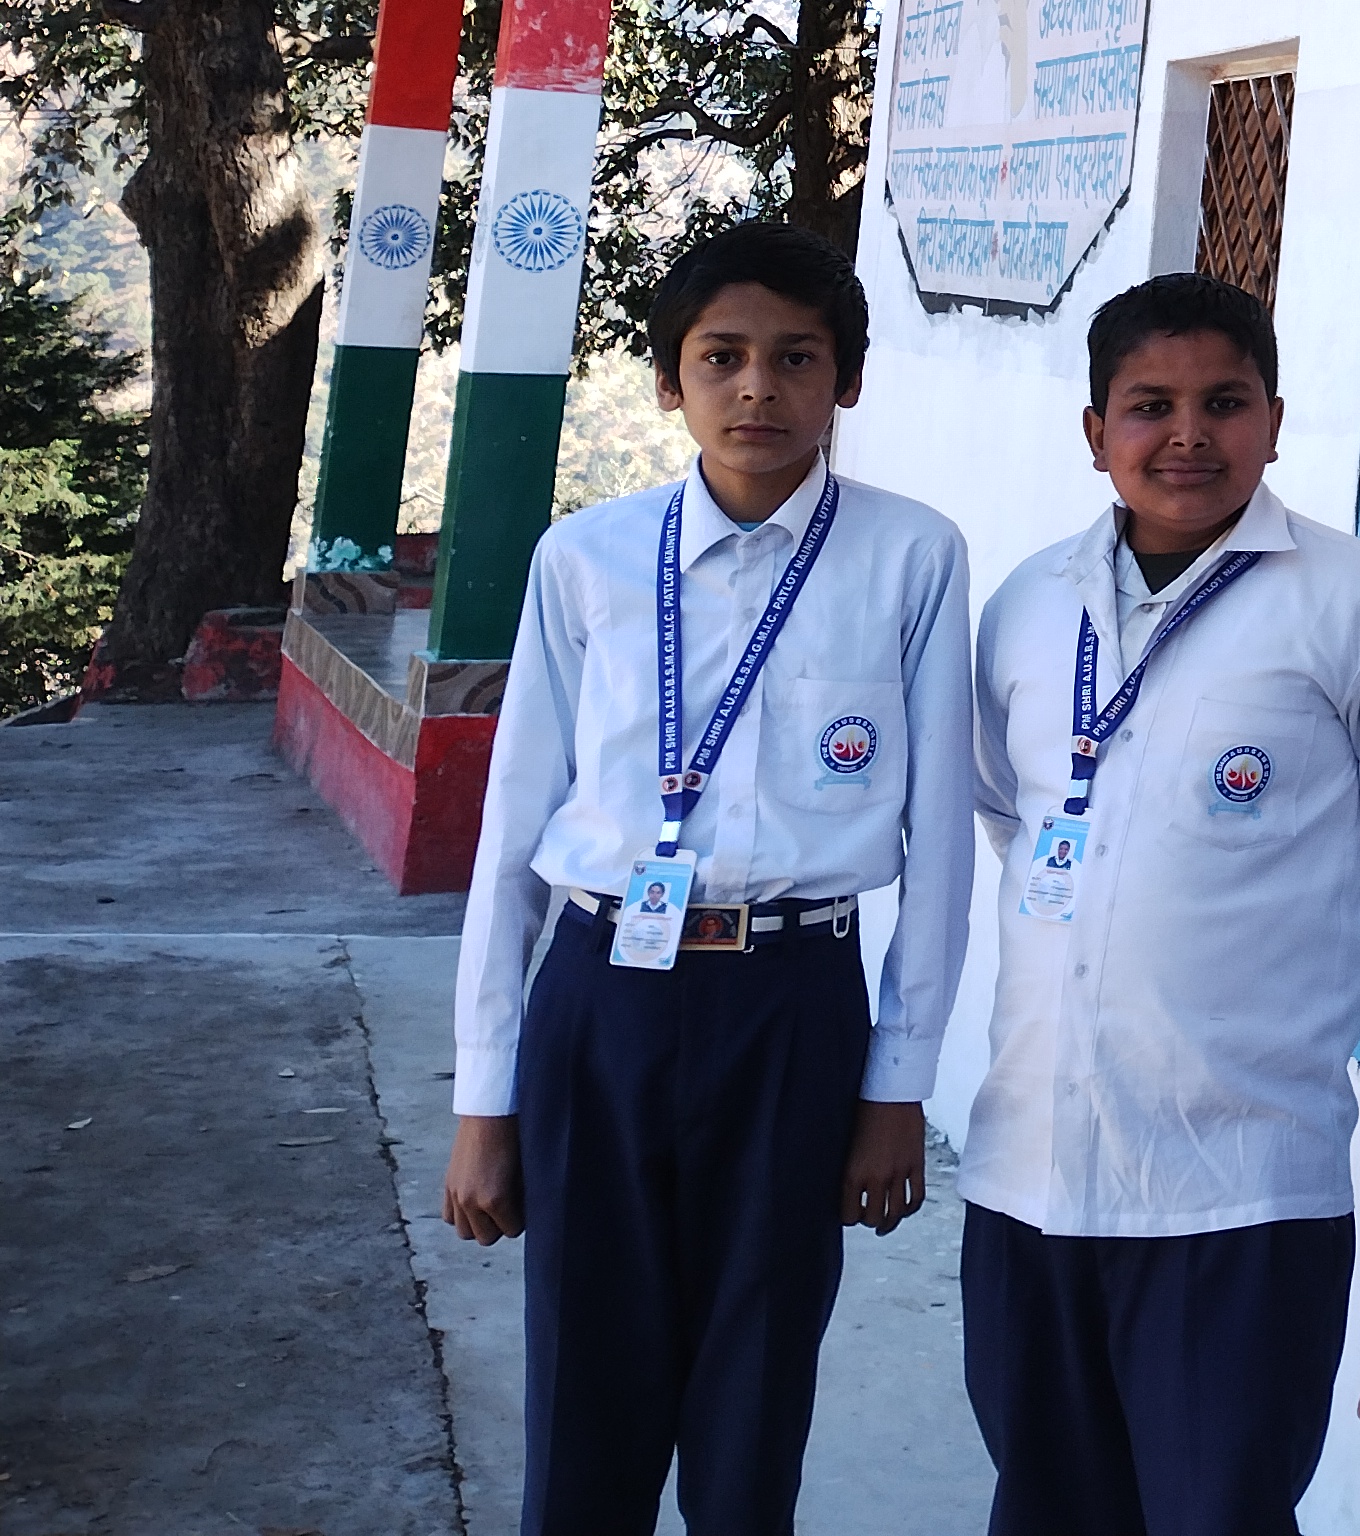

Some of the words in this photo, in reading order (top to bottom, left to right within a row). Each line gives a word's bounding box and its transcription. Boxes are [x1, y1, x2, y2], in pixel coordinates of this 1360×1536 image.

[663, 567, 675, 608] PATLOT
[697, 743, 712, 767] PM
[708, 719, 726, 748] SHRI
[772, 568, 800, 612] PATLOT
[796, 521, 825, 571] NAINITAL
[1081, 684, 1092, 711] SHRI
[1081, 713, 1092, 730] PM
[1092, 717, 1109, 737] PM
[1105, 692, 1128, 721] SHRI
[665, 723, 676, 749] SHRI
[665, 751, 676, 769] PM
